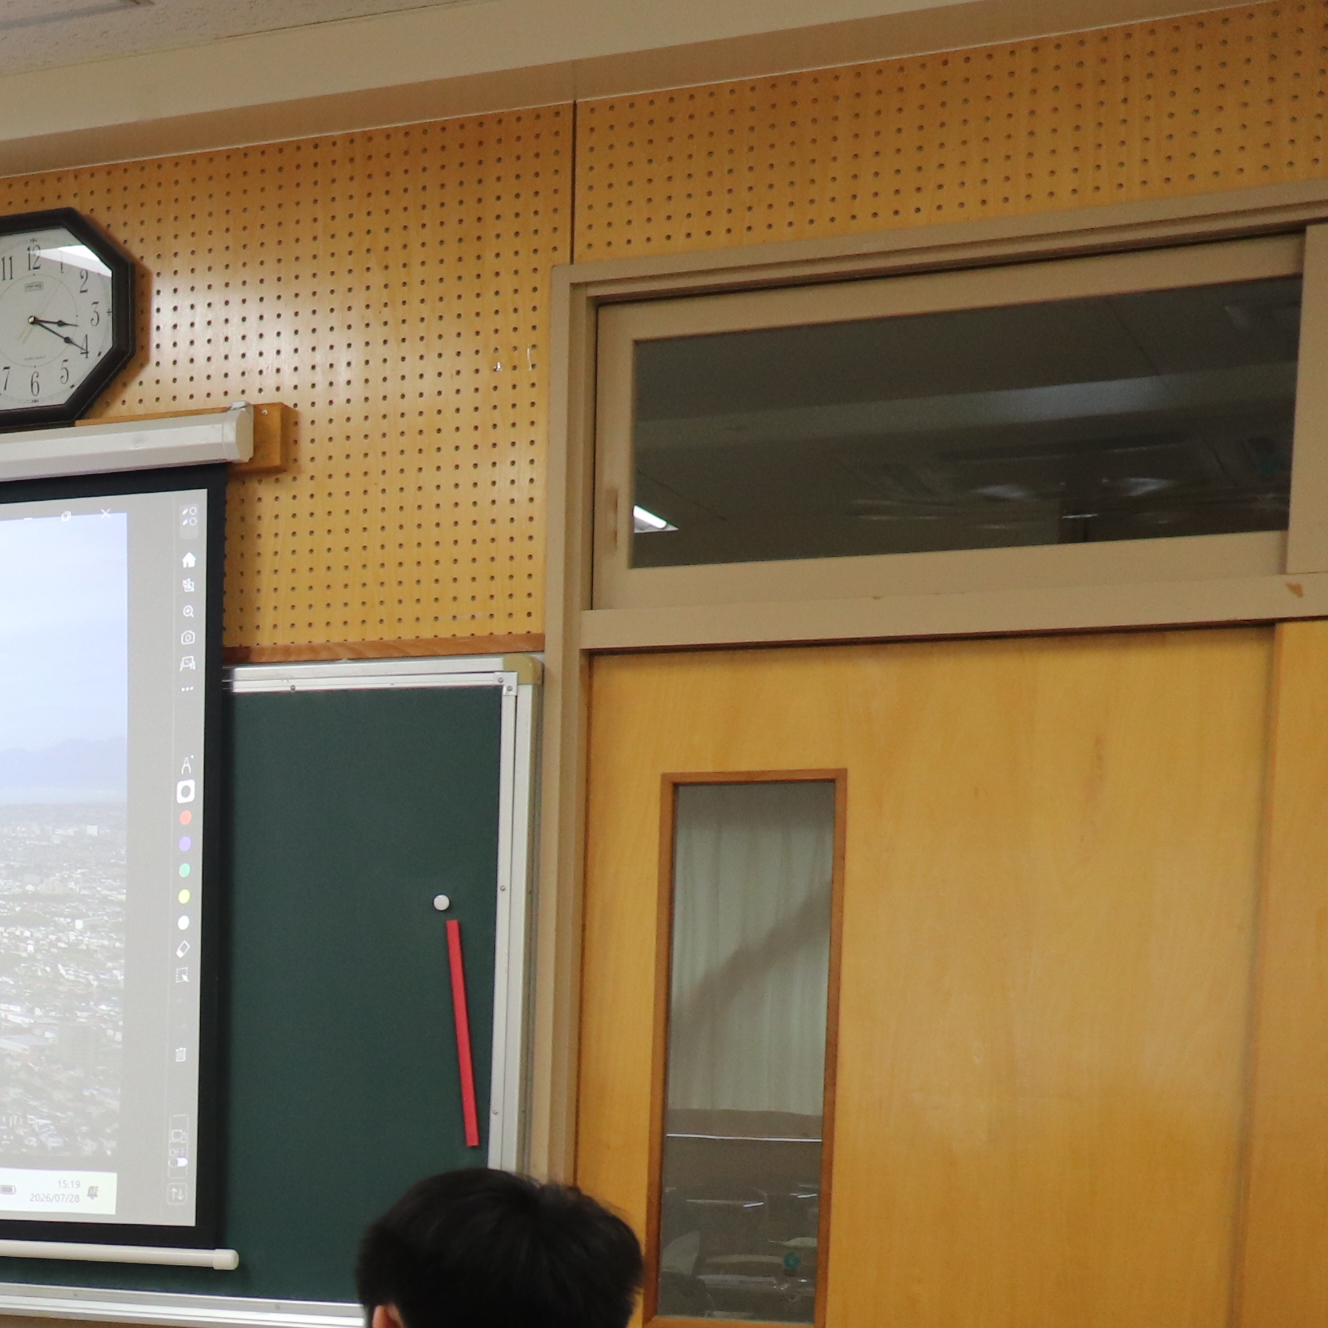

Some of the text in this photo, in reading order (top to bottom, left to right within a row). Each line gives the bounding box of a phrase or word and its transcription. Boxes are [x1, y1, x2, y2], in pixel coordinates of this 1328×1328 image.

[1, 257, 13, 281] 11
[27, 245, 42, 271] 12
[79, 269, 88, 293] 2
[90, 301, 100, 326] 3
[80, 334, 89, 358] 4
[3, 366, 11, 391] 7
[30, 371, 40, 396] 6
[60, 359, 69, 384] 5
[58, 1180, 80, 1189] 15:19
[29, 1193, 80, 1203] 2026/07/28
